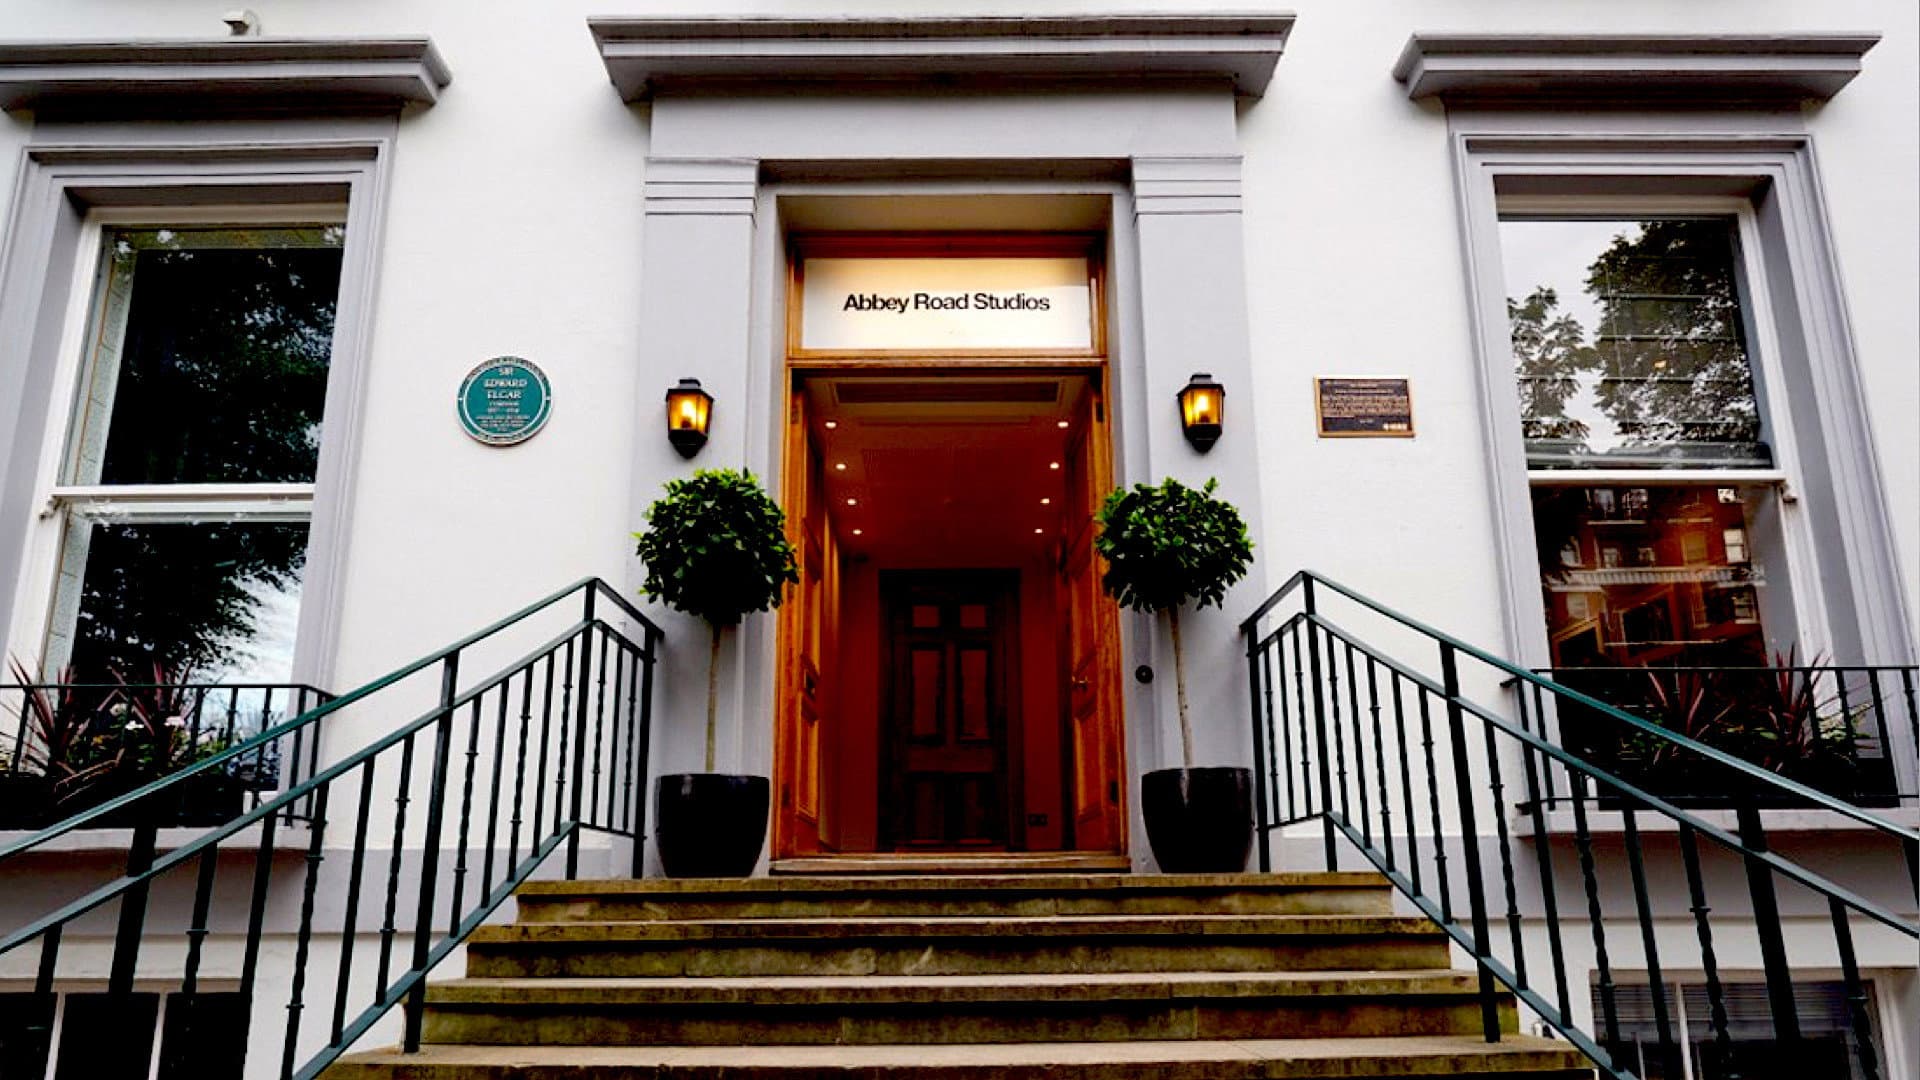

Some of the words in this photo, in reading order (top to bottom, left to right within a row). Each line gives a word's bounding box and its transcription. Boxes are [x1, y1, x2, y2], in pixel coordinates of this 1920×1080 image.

[844, 293, 909, 313] Abbey
[913, 293, 969, 310] Road
[973, 293, 1050, 311] Studios
[484, 379, 527, 388] EDWARD
[487, 390, 521, 399] ELGAR
